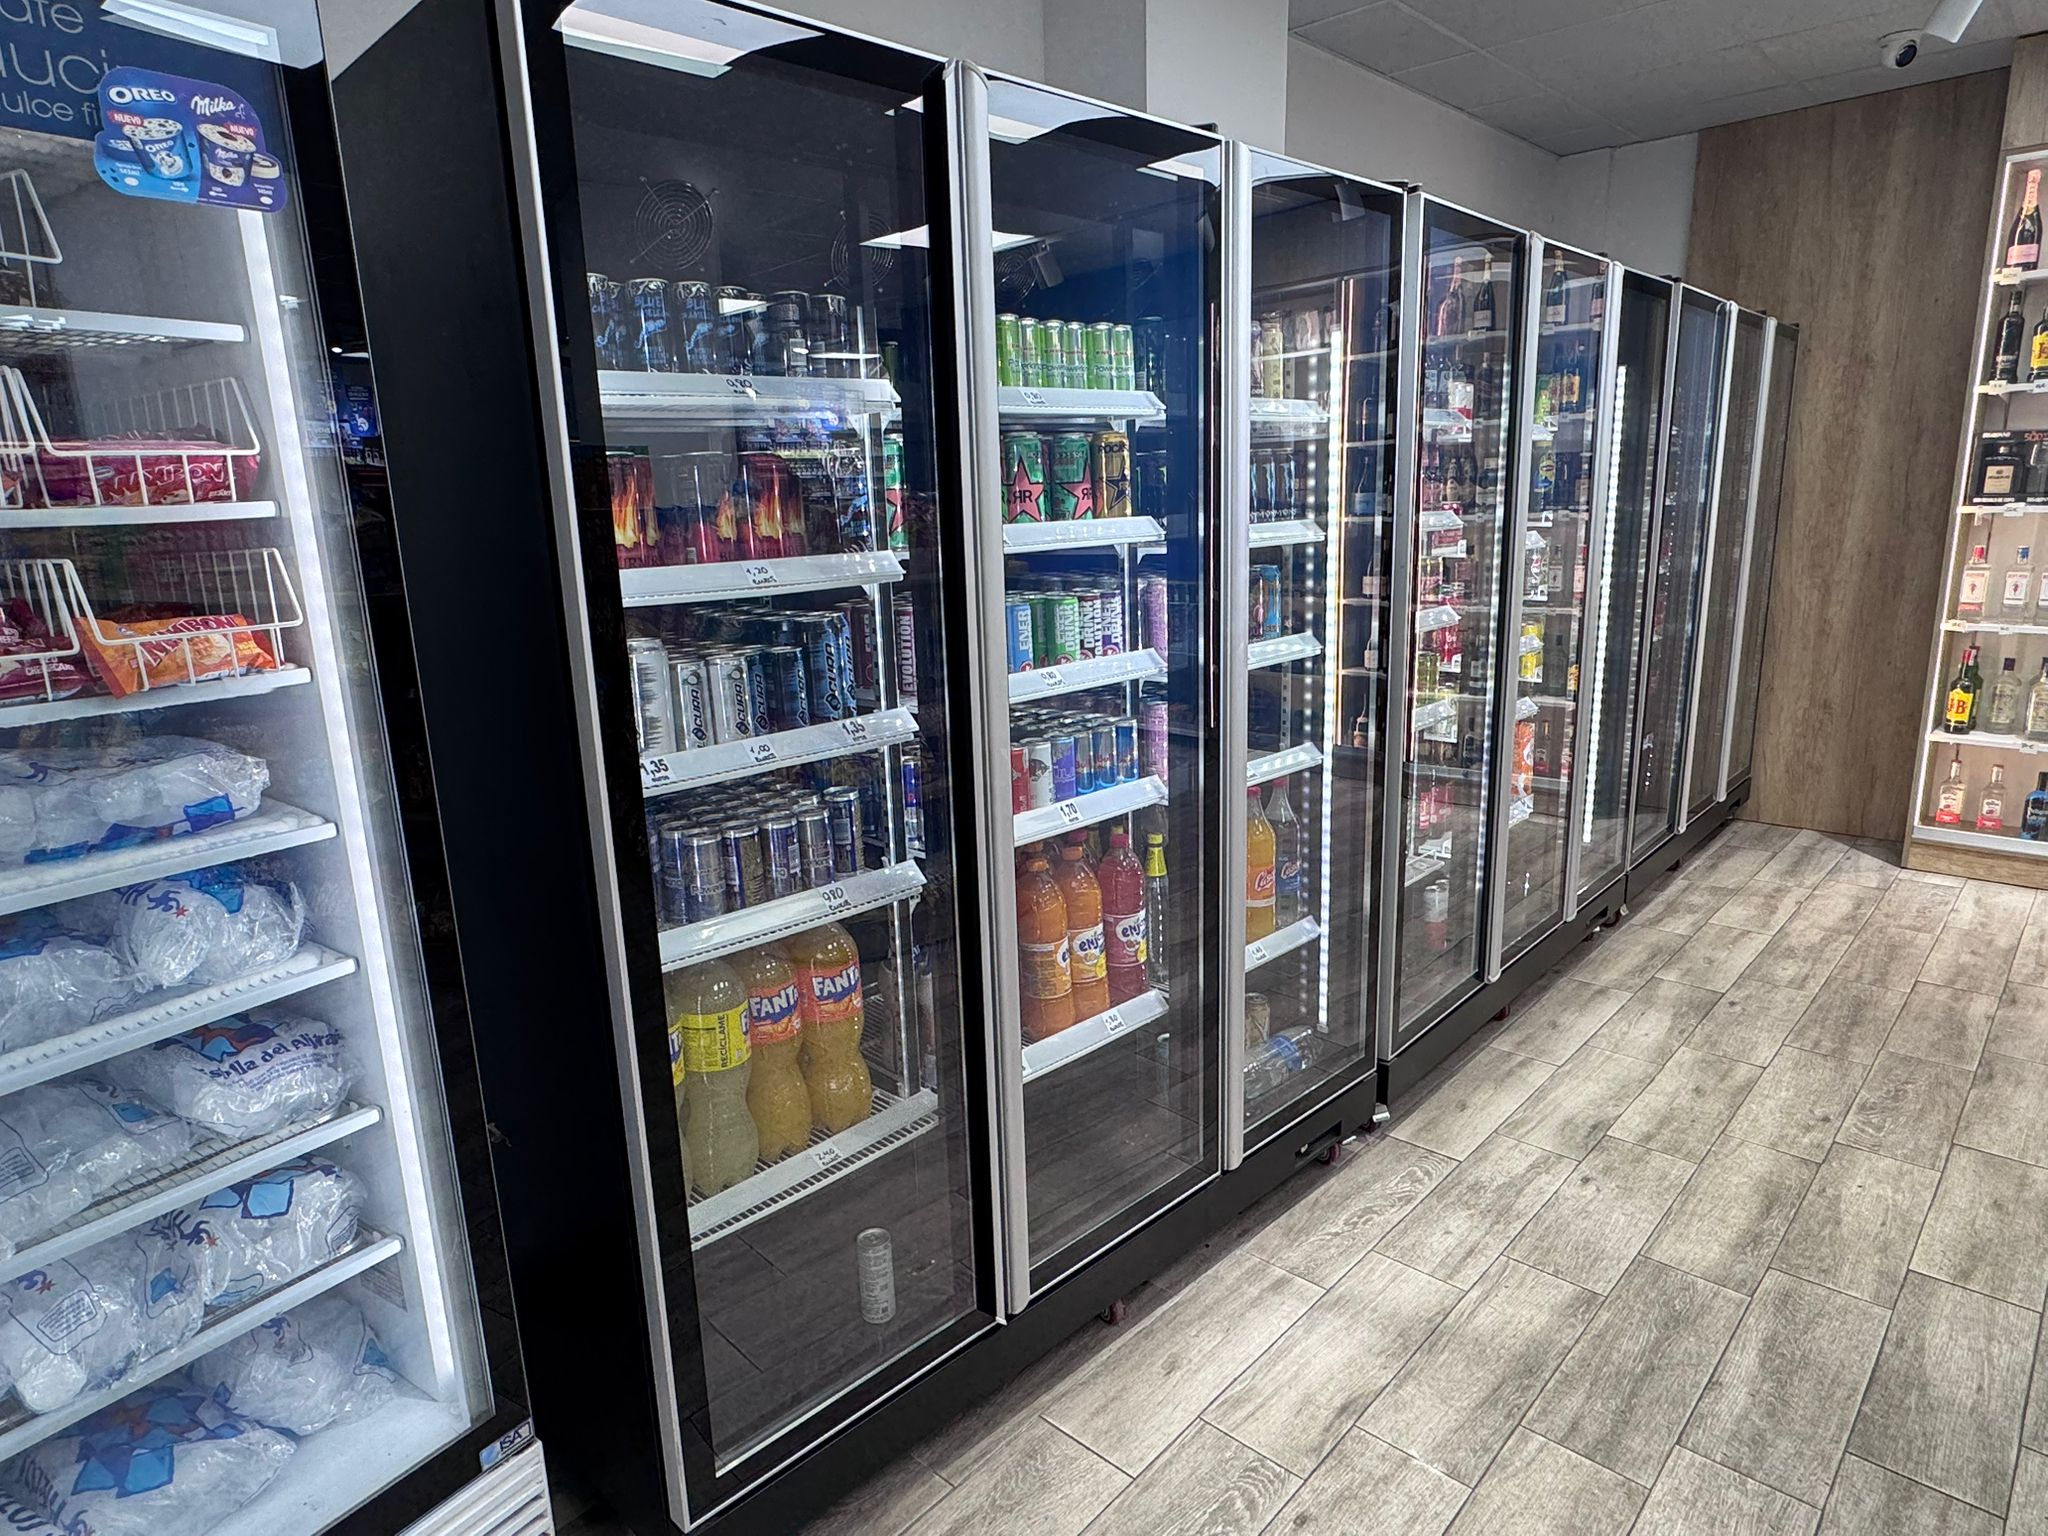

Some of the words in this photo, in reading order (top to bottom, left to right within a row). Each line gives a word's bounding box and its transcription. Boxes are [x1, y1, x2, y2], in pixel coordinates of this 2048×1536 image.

[0, 0, 84, 33] ate
[108, 86, 176, 105] OREO
[190, 95, 236, 116] Milka
[2, 90, 74, 122] ulce
[114, 113, 143, 126] NUEVO
[899, 614, 914, 693] EVOLUTION
[841, 720, 865, 736] 1,35
[641, 758, 669, 778] 1,35
[1060, 802, 1079, 817] 1,70
[720, 1014, 728, 1070] RECICLAME
[261, 1043, 291, 1063] del
[499, 1430, 523, 1452] ISA
